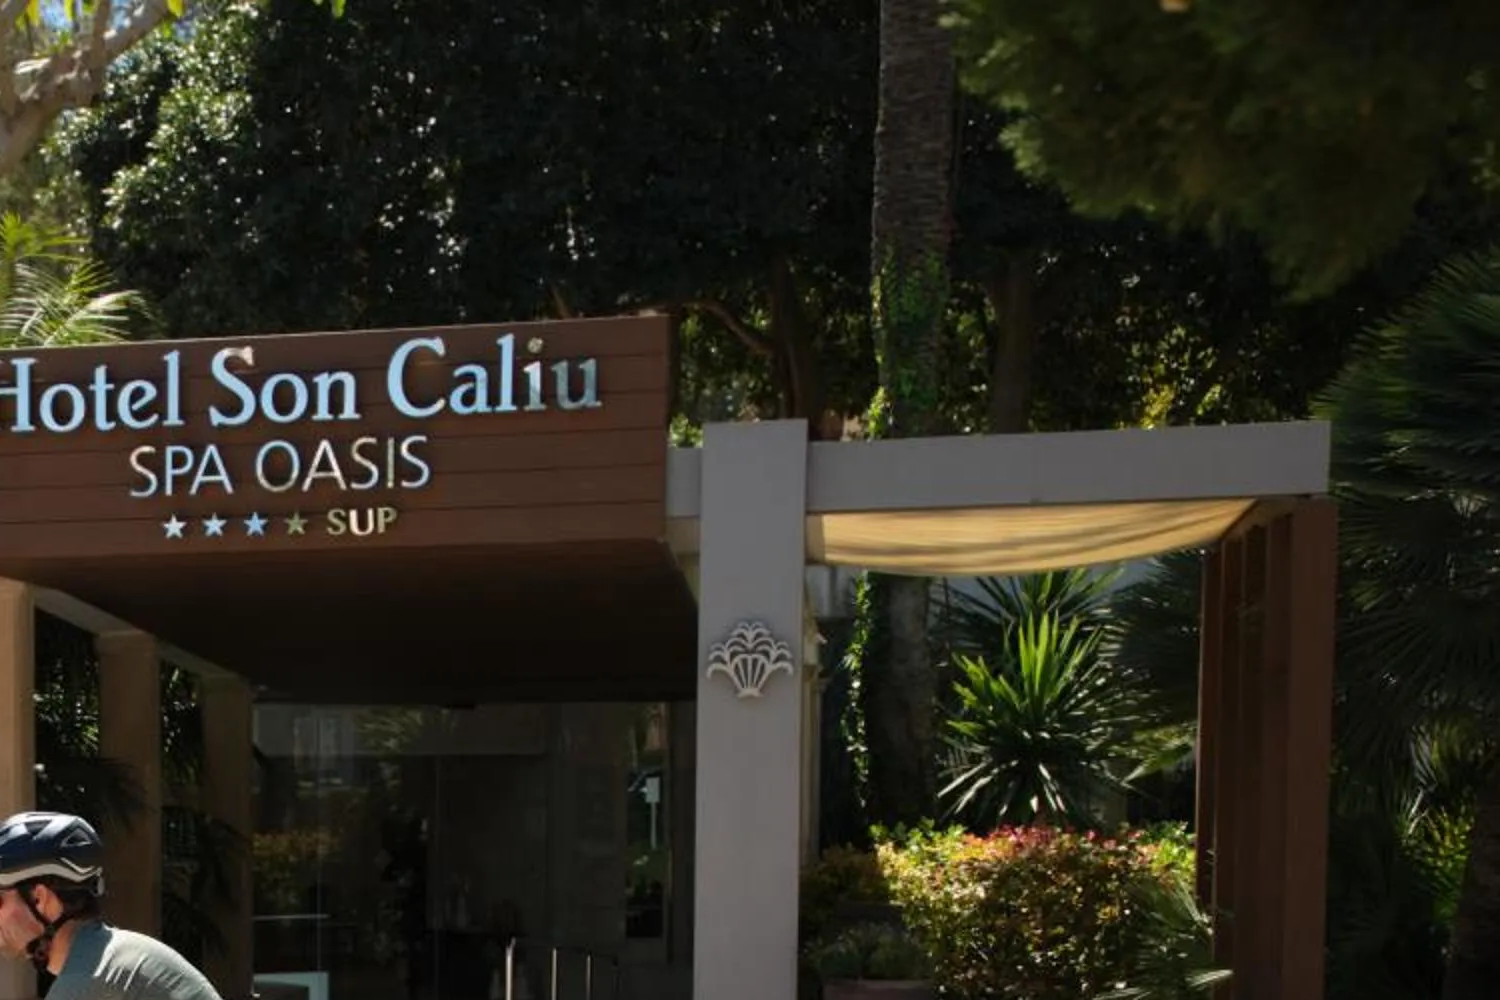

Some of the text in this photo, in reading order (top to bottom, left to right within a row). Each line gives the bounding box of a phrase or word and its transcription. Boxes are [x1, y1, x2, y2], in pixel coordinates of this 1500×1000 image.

[209, 346, 361, 427] Son
[387, 333, 602, 418] Caliu
[130, 435, 431, 498] SPA OASIS
[326, 507, 397, 536] SUP
